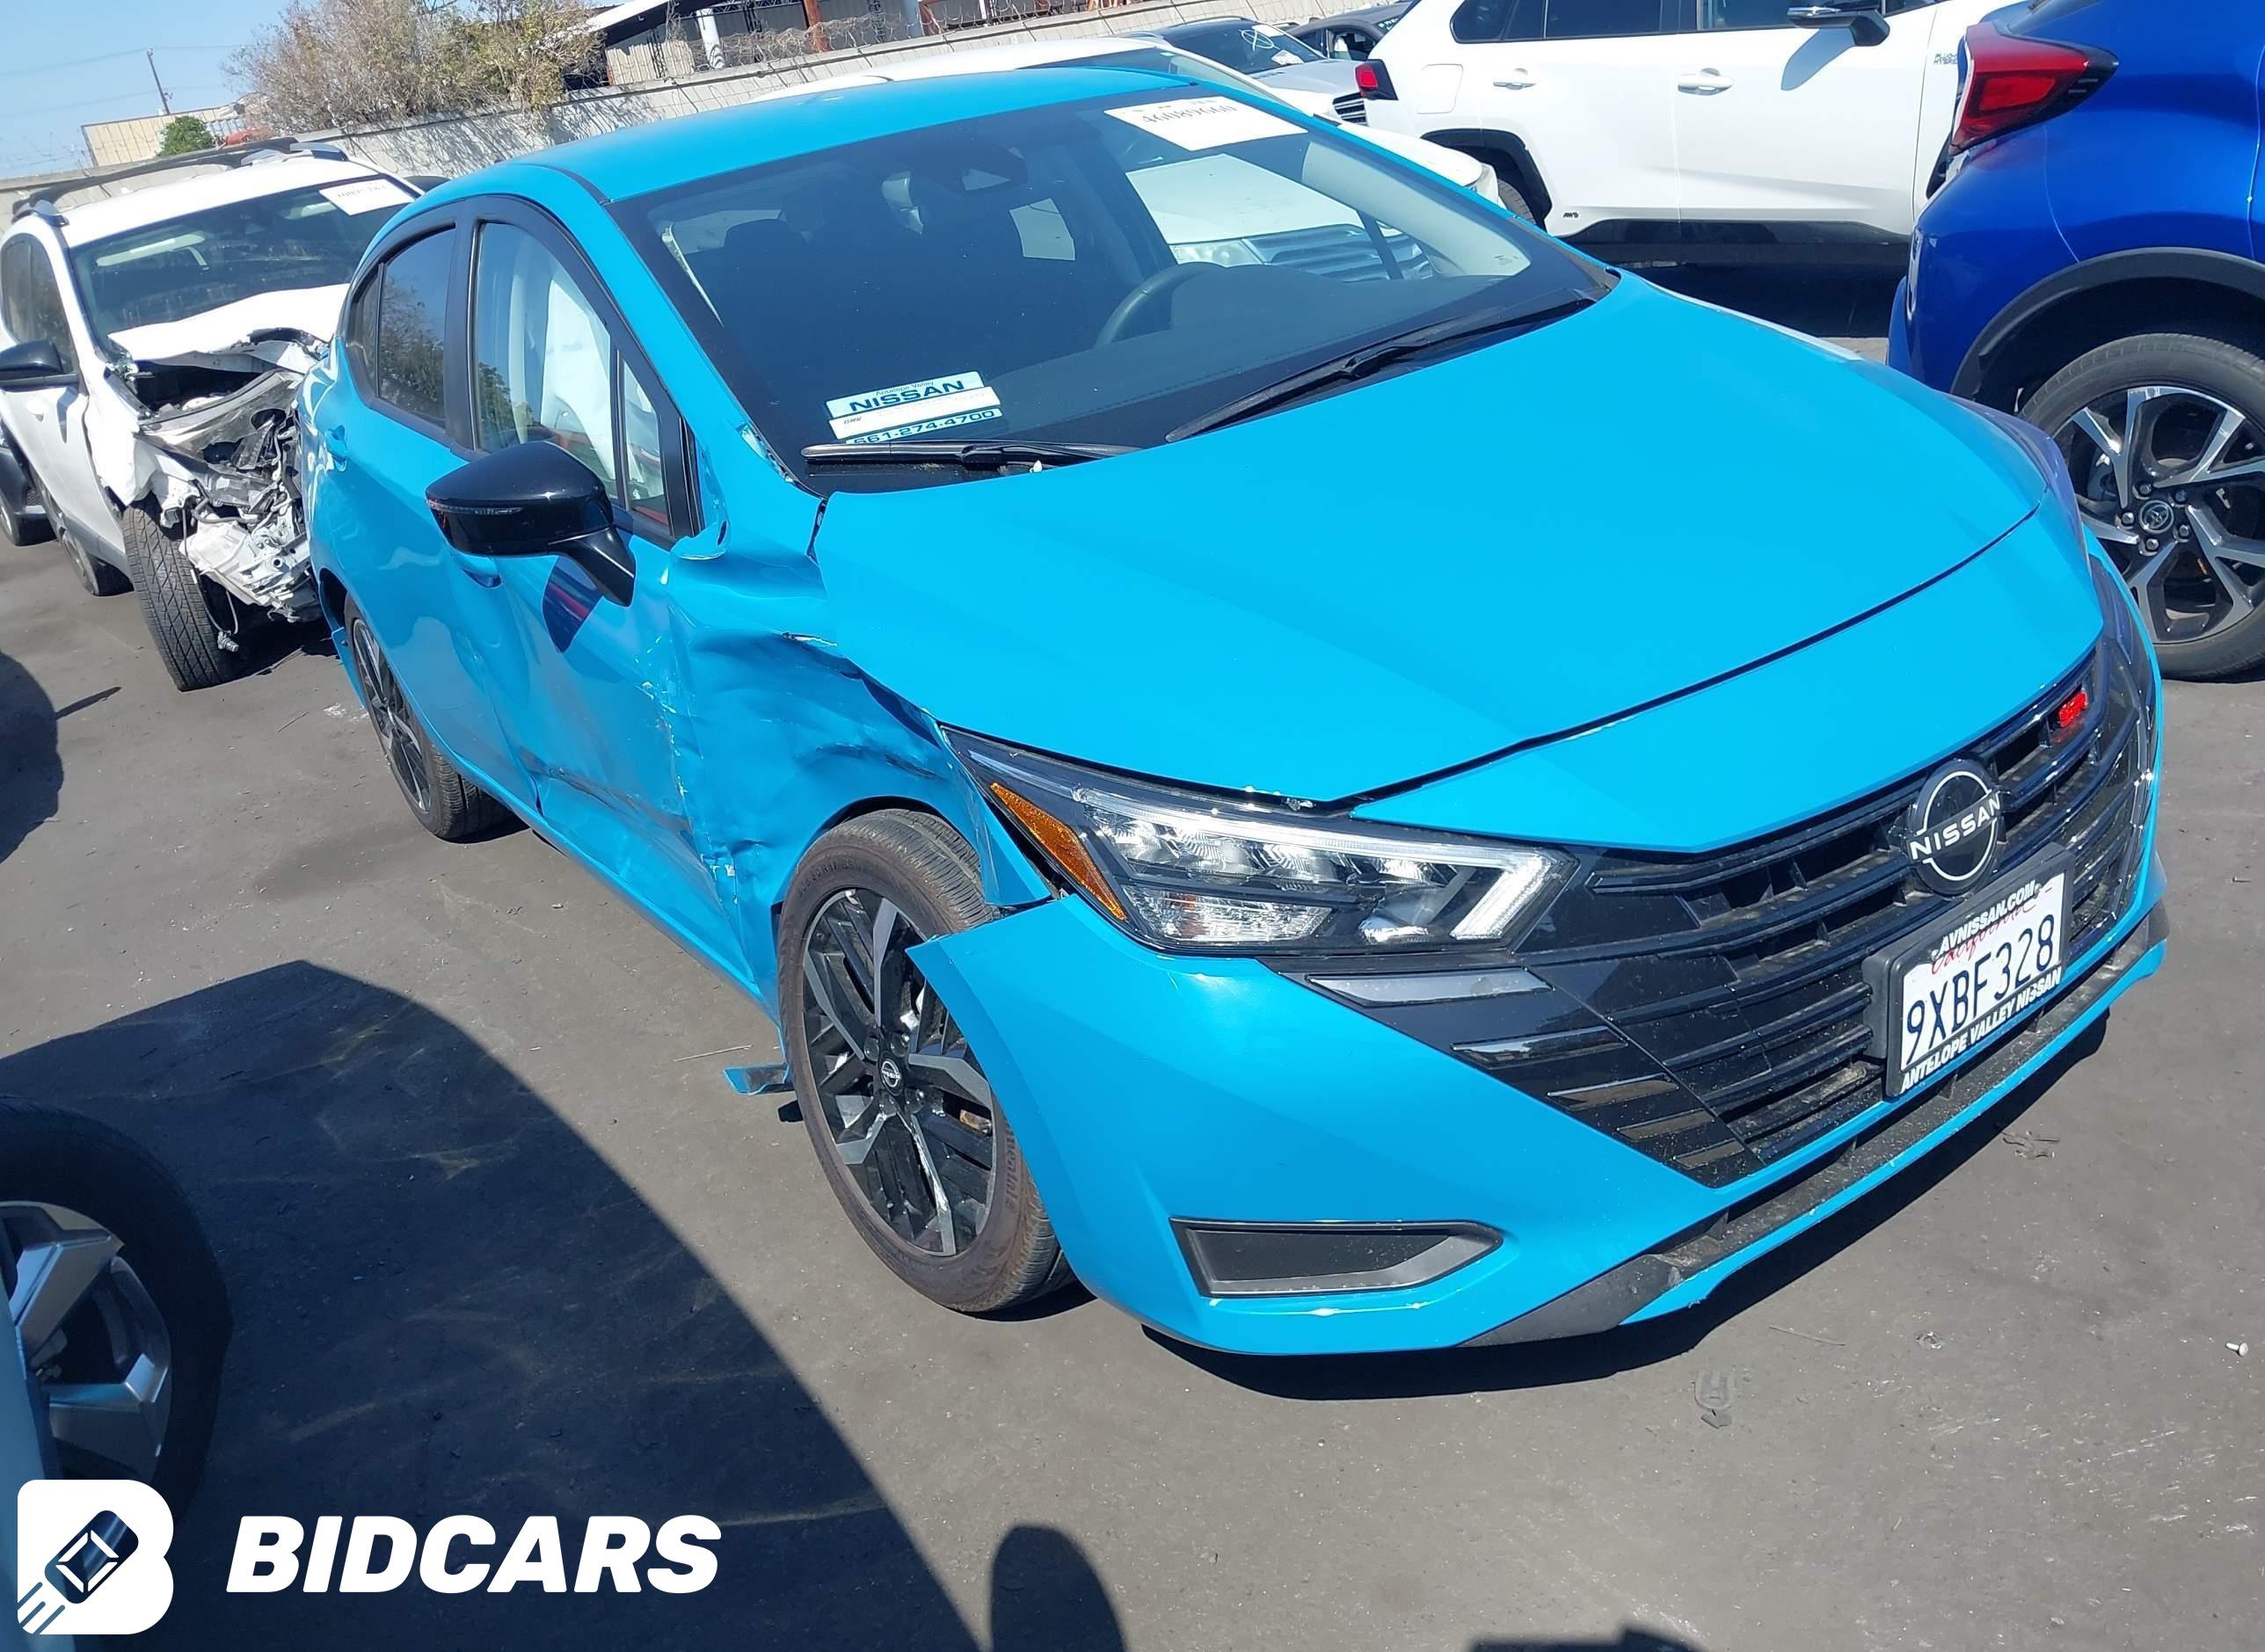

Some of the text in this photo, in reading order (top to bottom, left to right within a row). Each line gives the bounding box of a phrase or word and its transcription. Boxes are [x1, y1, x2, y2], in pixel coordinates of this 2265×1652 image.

[849, 380, 964, 412] NISSAN
[1909, 790, 2001, 861] NISSAN
[1938, 879, 2036, 954] AVNISSAN.COM
[1906, 913, 2055, 1066] 9XBF328
[1901, 966, 2063, 1095] ANTELOPE VALLEY NISSAN
